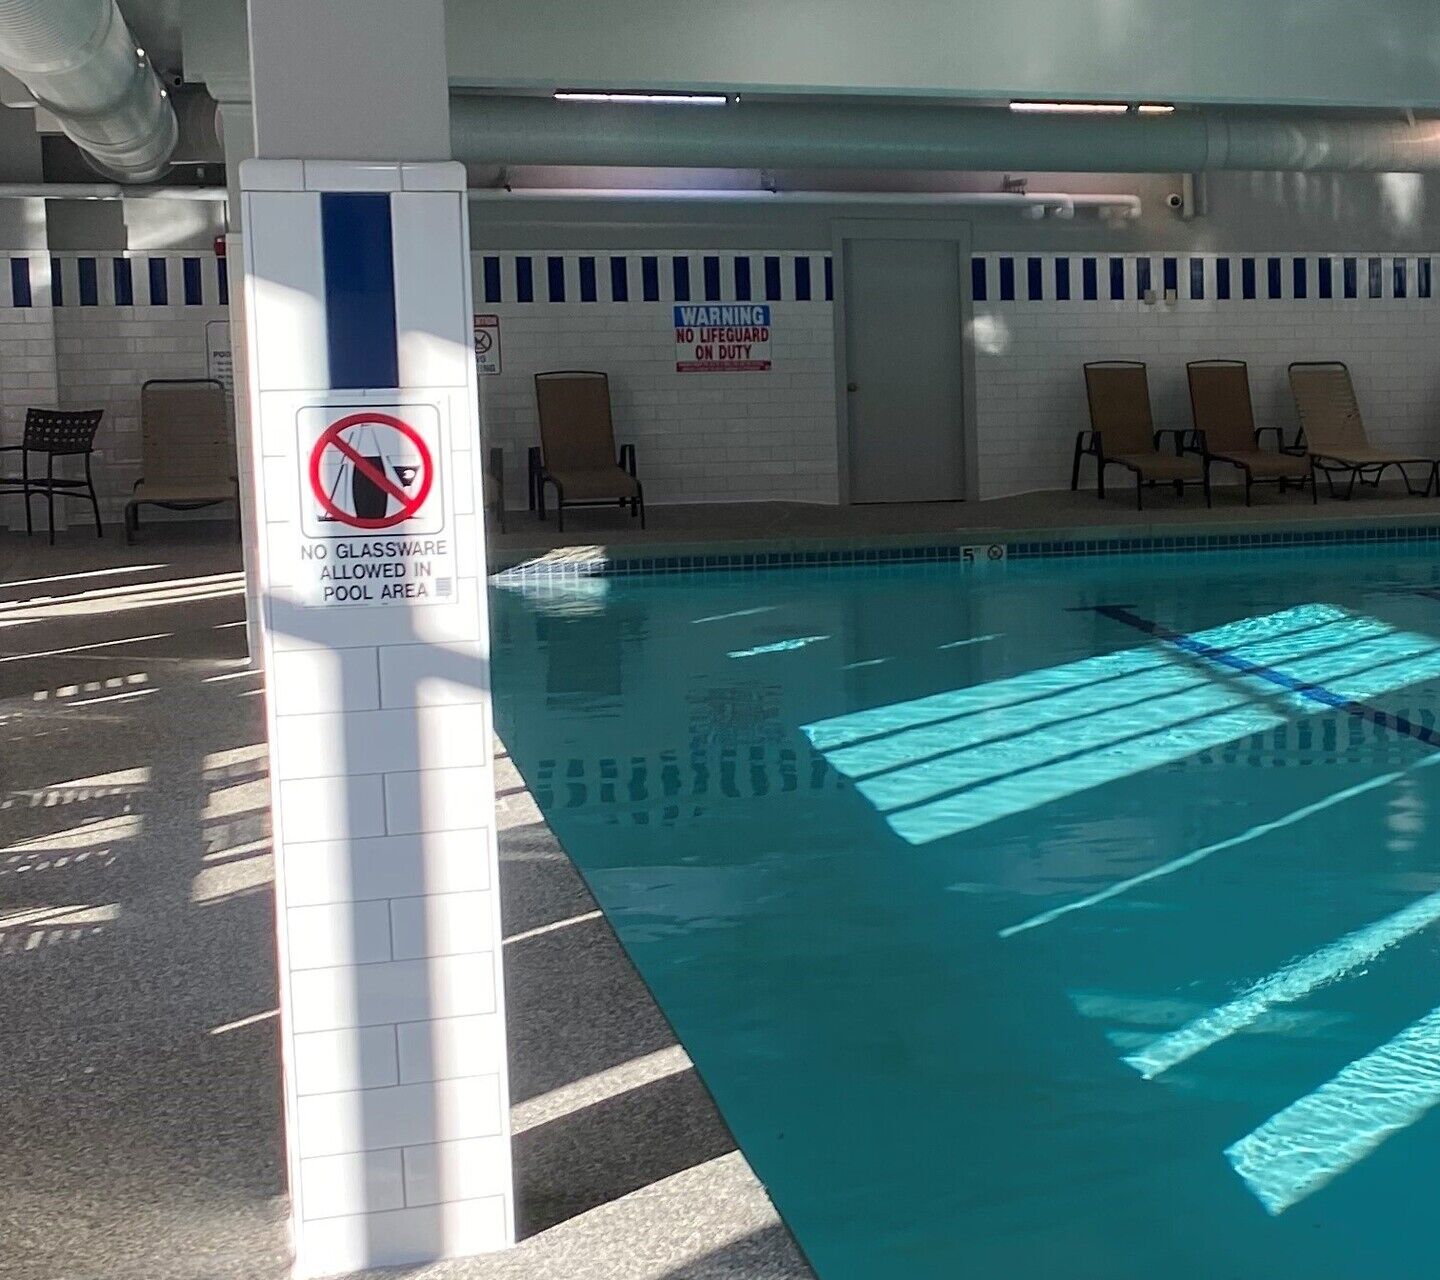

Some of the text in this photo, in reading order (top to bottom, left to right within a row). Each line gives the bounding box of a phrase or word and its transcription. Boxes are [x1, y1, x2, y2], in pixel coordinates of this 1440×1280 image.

[680, 306, 764, 326] WARNING
[676, 327, 769, 343] NO LIFEGUARD
[695, 344, 752, 360] ON DUTY
[301, 540, 448, 560] NO GLASSWARE
[320, 561, 431, 580] ALLOWED IN
[324, 584, 373, 602] POOL
[381, 583, 429, 600] AREA
